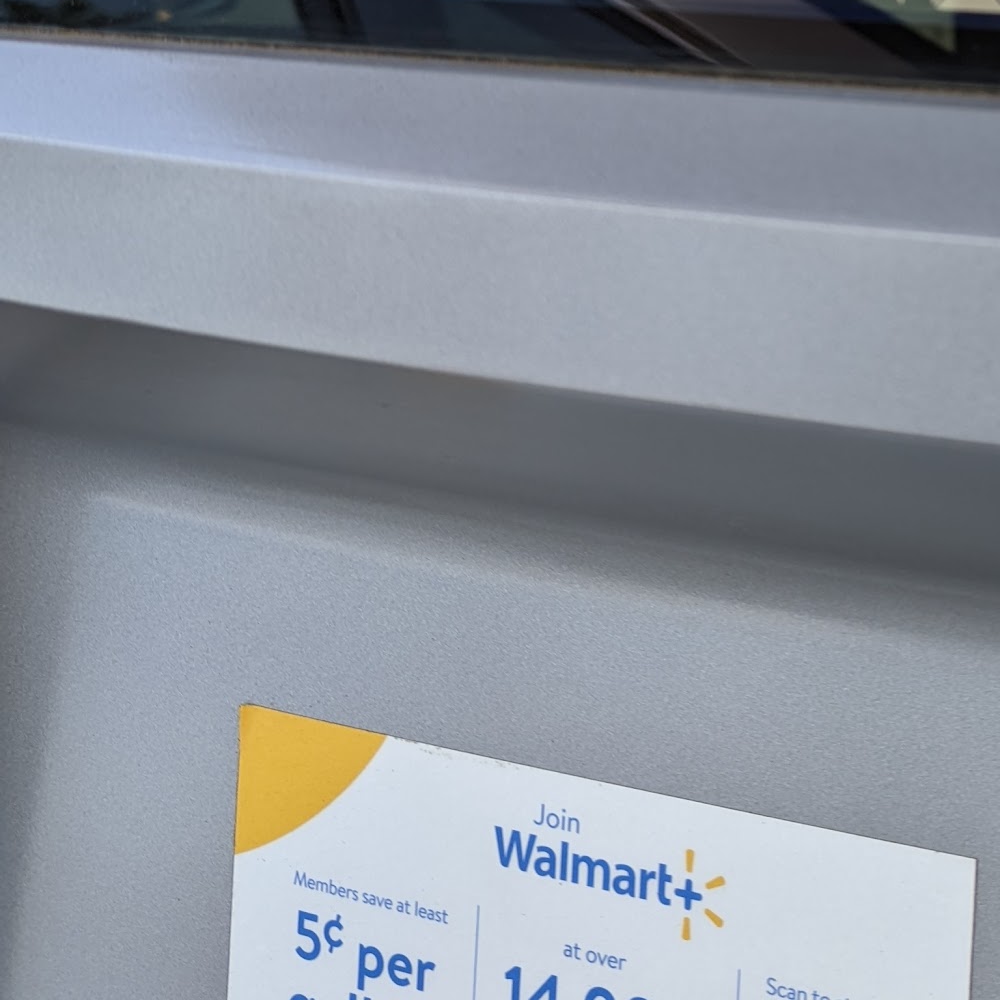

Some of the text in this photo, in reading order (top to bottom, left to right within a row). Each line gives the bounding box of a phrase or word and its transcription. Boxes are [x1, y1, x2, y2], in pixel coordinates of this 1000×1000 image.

[533, 803, 580, 834] Join
[293, 870, 449, 924] Members save at least
[295, 910, 436, 992] 5¢ per
[563, 943, 627, 970] at over
